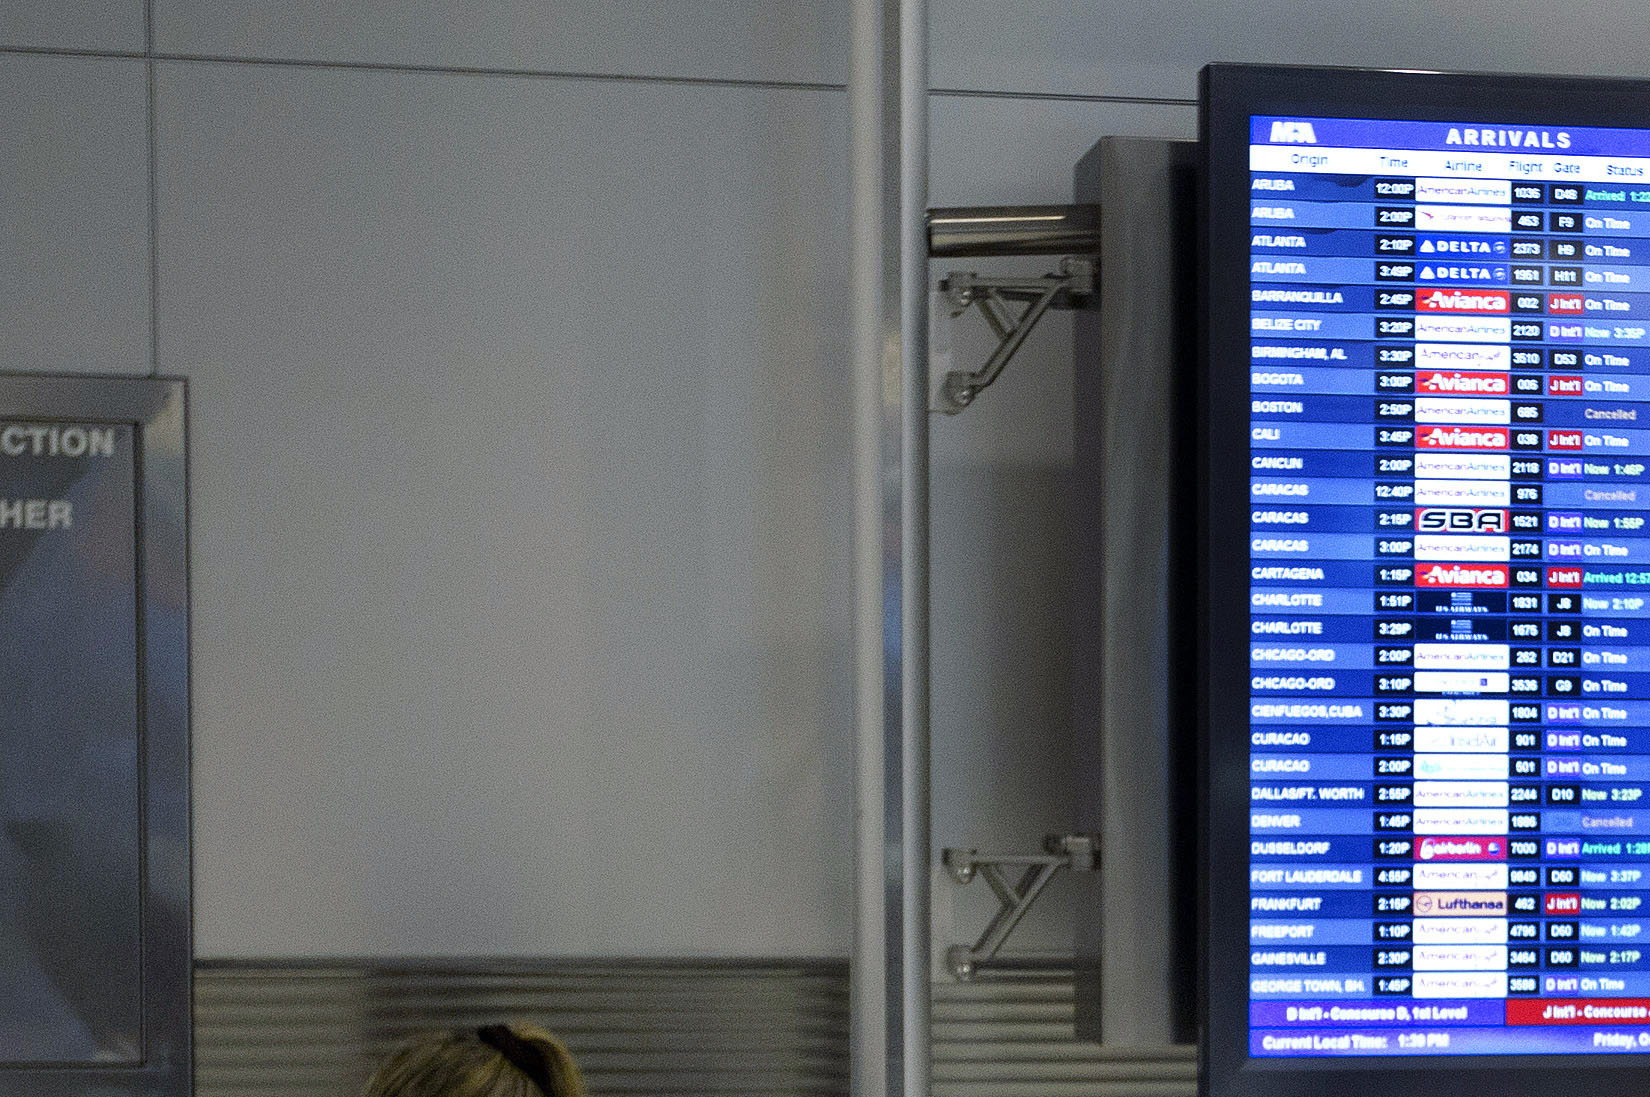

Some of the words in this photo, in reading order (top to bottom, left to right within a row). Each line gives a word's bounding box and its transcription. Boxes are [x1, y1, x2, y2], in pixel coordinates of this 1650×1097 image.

[1445, 127, 1571, 149] ARRIVALS
[1292, 154, 1328, 166] Origin
[1380, 156, 1408, 168] Time
[1444, 161, 1483, 172] Airline
[1509, 160, 1542, 173] Flight
[1553, 162, 1580, 174] Gate
[1606, 165, 1644, 177] Status
[1251, 177, 1295, 191] ARUBA
[1251, 234, 1306, 248] ATLANTA
[1433, 240, 1491, 254] DELTA
[1584, 244, 1603, 257] On
[1602, 245, 1631, 257] Time
[1433, 266, 1491, 280] DELTA
[1427, 289, 1507, 310] Avianca
[1584, 298, 1603, 310] On
[1602, 299, 1631, 311] Time
[1293, 318, 1322, 331] CITY
[1329, 347, 1347, 360] AL
[1251, 372, 1304, 386] BOGOTA
[1427, 372, 1507, 393] Avianca
[1251, 400, 1304, 414] BOSTON
[1583, 408, 1637, 420] Cancelled
[1, 425, 115, 458] CTION
[1251, 427, 1280, 441] CALI
[1427, 427, 1507, 447] Avianca
[0, 499, 73, 529] HER
[1251, 510, 1309, 524] CARACAS
[1421, 511, 1502, 530] SBA
[1251, 538, 1309, 552] CARACAS
[1251, 566, 1324, 580] CARTAGENA
[1426, 564, 1506, 584] Avianca
[1582, 571, 1624, 584] Arrived
[1251, 620, 1323, 634] CHARLOTTE
[1251, 732, 1311, 745] CURACAO
[1318, 787, 1365, 800] WORTH
[1250, 813, 1301, 828] DENVER
[1250, 841, 1330, 855] DUSSELDORF
[1250, 869, 1284, 883] FORT
[1284, 869, 1362, 883] LAUDERDALE
[1250, 896, 1322, 911] FRANKFURT
[1436, 897, 1503, 911] Lufthansa
[1250, 924, 1314, 939] FREEPORT
[1250, 951, 1326, 966] GAINESVILLE
[1542, 1004, 1553, 1019] J
[1583, 1006, 1648, 1019] Concourse
[1261, 1036, 1313, 1050] Current
[1312, 1035, 1351, 1050] Local
[1350, 1034, 1388, 1050] Time:
[1592, 1032, 1638, 1049] Friday,
